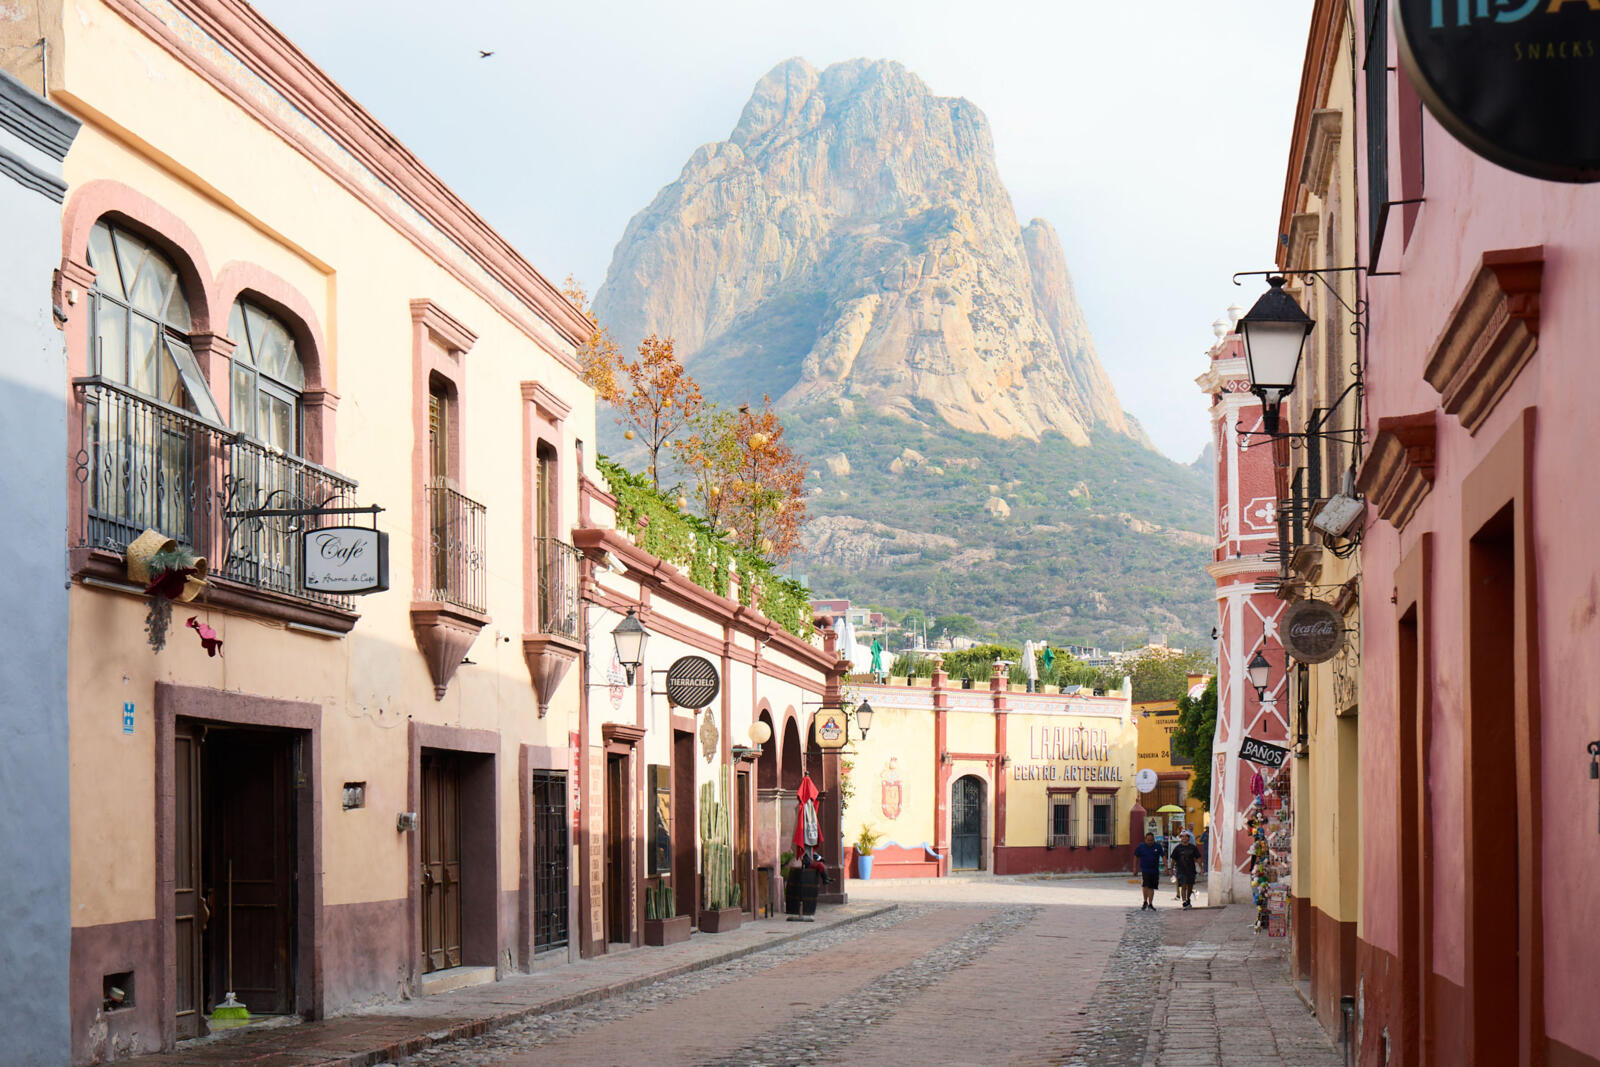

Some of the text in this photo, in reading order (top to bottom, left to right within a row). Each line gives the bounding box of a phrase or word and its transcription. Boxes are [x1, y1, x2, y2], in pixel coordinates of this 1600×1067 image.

[1514, 40, 1595, 61] SNACKS
[315, 533, 368, 567] Café
[670, 678, 715, 687] TIERRACIELO
[1052, 726, 1110, 761] AURORA
[1243, 741, 1282, 764] BAÑOS
[1014, 764, 1122, 781] CENTRO ARTESANAL
